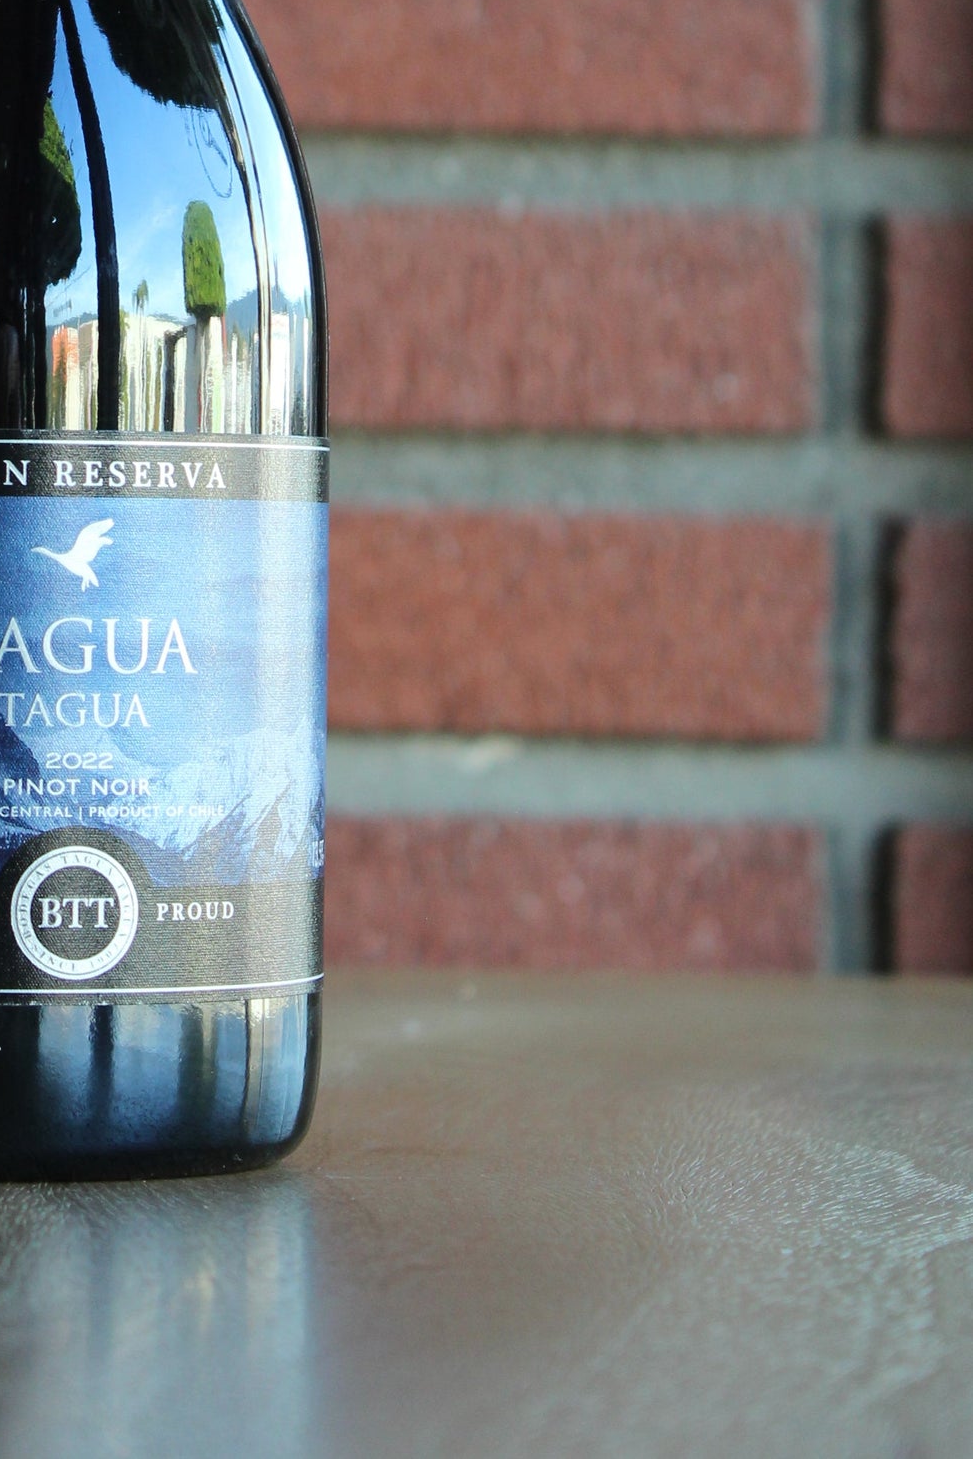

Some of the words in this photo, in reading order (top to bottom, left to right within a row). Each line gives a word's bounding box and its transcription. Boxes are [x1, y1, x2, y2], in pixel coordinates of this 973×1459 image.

[53, 460, 227, 489] RESERVA
[45, 752, 114, 769] 2022
[3, 778, 78, 796] PINOT
[91, 778, 151, 796] NOIR
[89, 806, 159, 818] PRODUCT
[166, 806, 184, 818] OF
[189, 805, 225, 818] CHILE
[38, 897, 115, 929] BTT
[156, 901, 235, 921] PROUD
